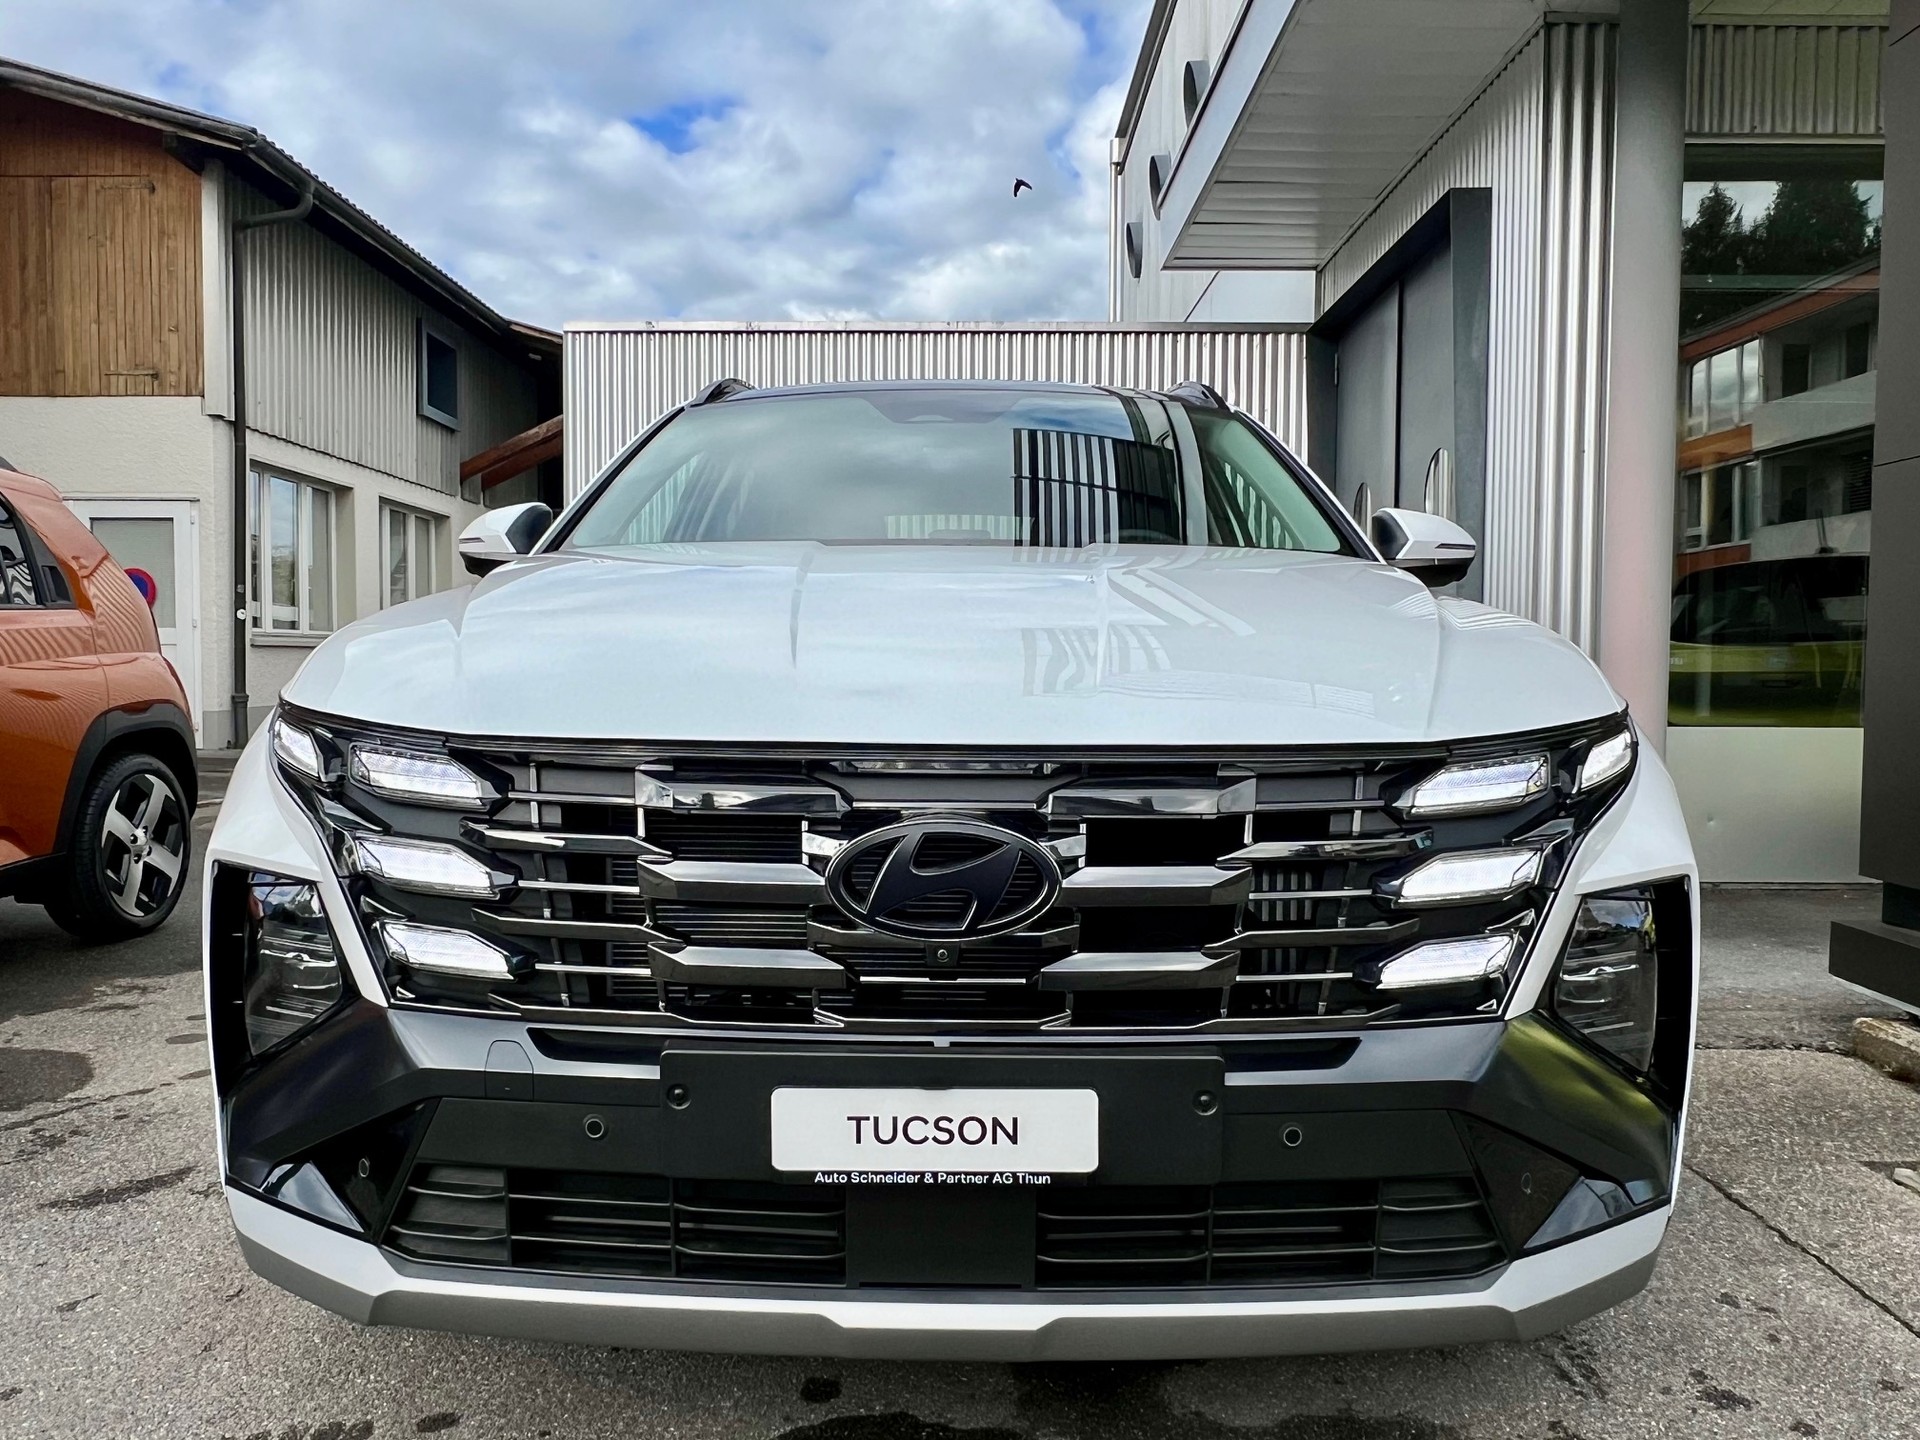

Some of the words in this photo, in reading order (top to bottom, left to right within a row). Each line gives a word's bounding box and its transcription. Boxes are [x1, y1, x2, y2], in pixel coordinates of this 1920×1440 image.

[846, 1115, 1018, 1146] TUCSON
[814, 1172, 848, 1183] Auto
[850, 1172, 921, 1184] Schneider
[923, 1172, 935, 1184] &
[937, 1172, 990, 1184] Partner
[992, 1172, 1014, 1185] AG
[1016, 1172, 1051, 1185] Thun
